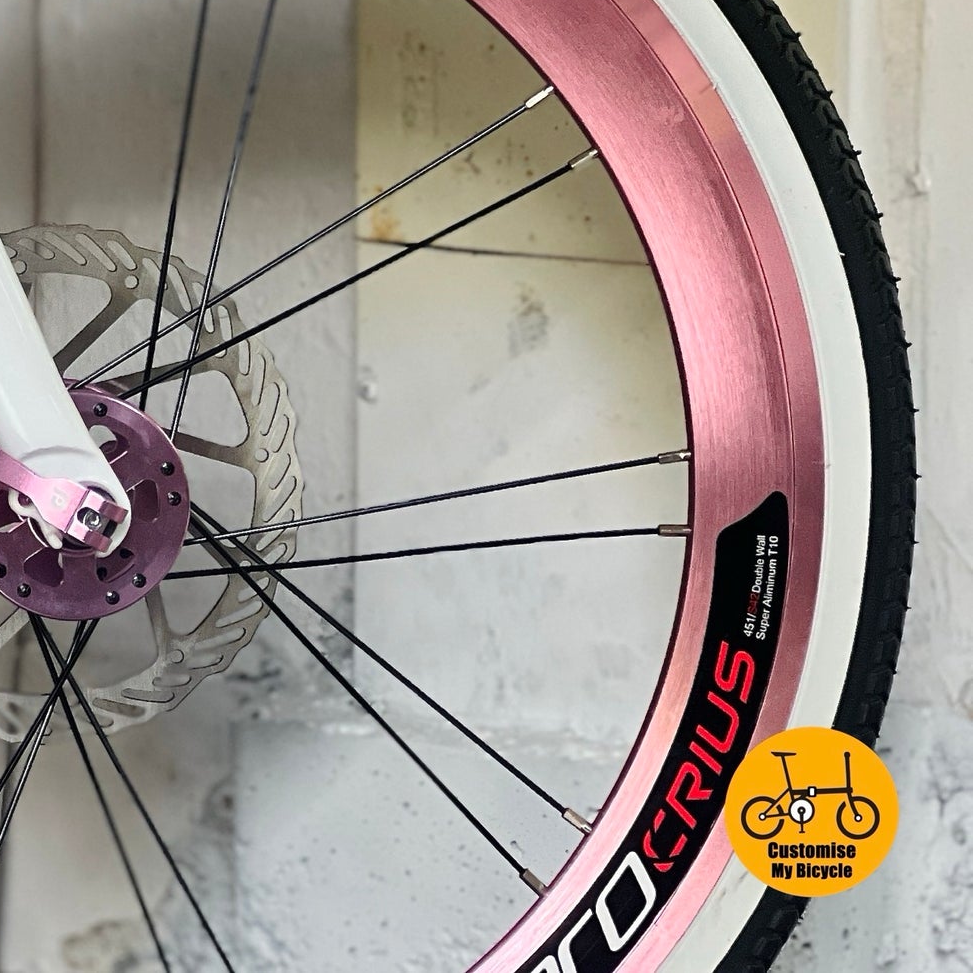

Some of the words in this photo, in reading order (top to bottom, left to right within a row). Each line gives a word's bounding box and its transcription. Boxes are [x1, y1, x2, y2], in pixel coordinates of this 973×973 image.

[755, 535, 766, 556] Wall
[755, 608, 770, 641] Super
[768, 535, 779, 556] T10
[642, 640, 756, 872] CRIUS
